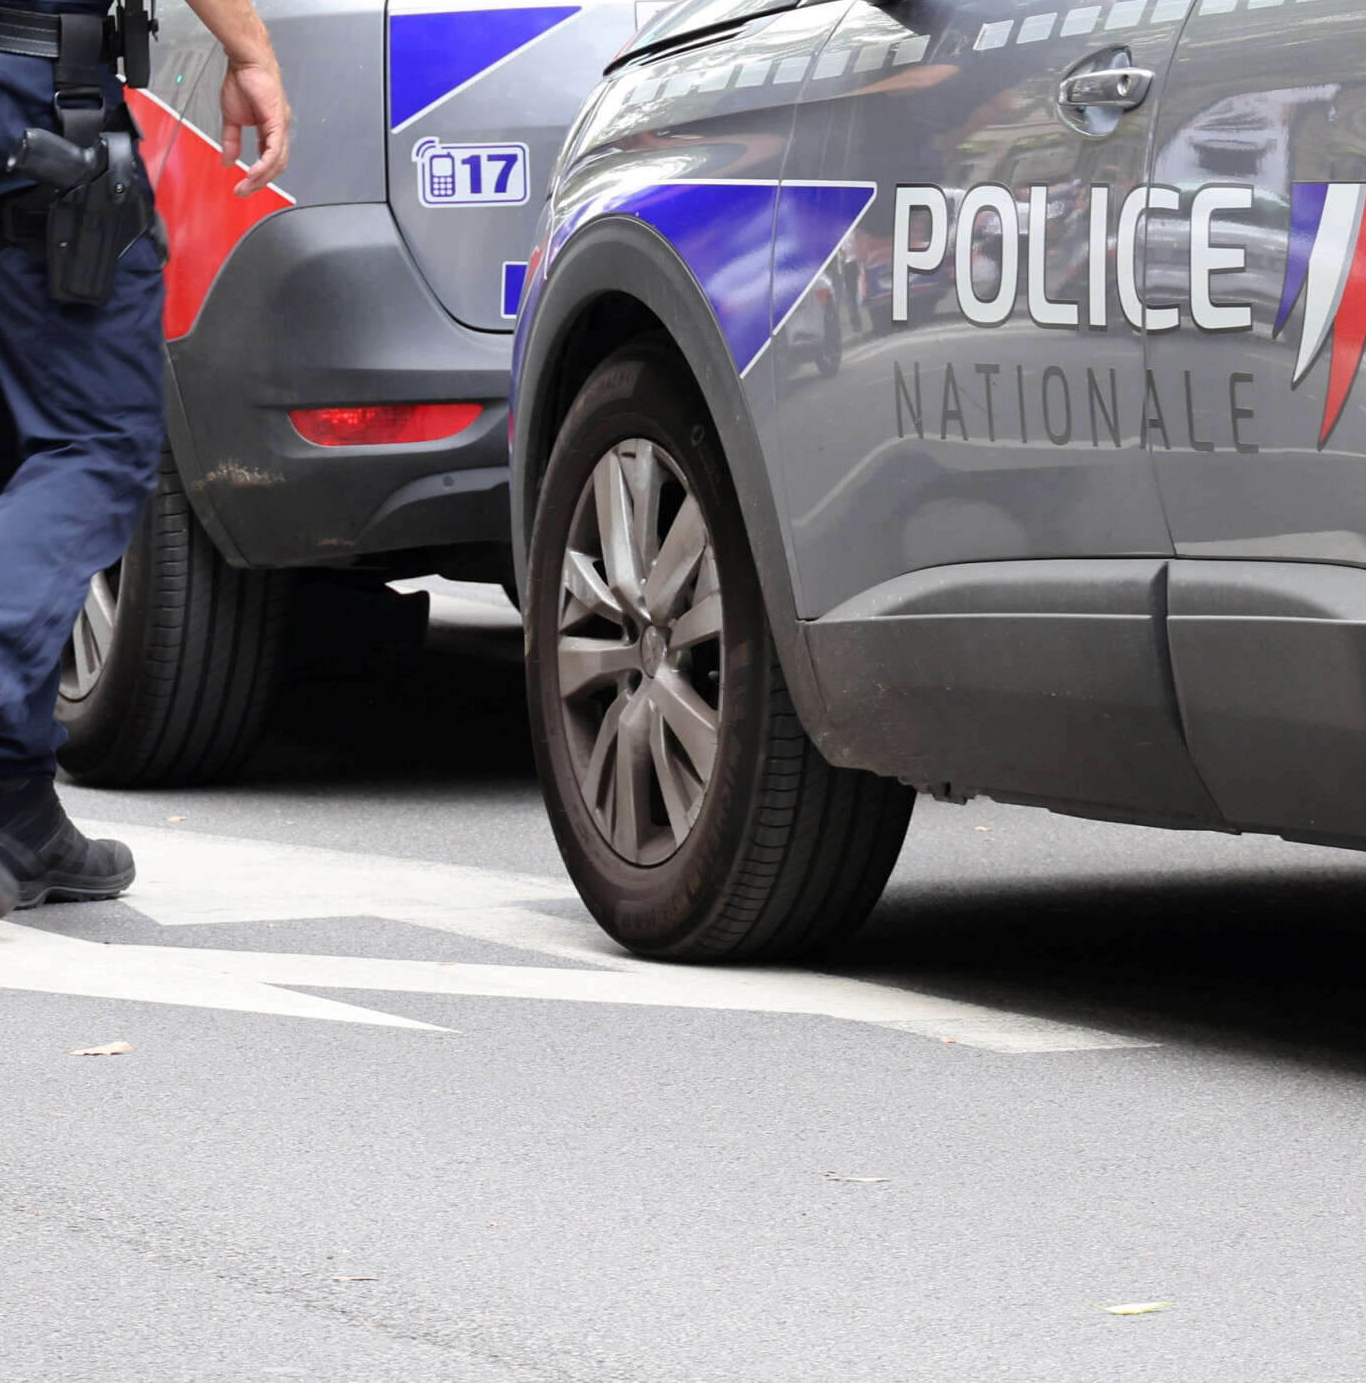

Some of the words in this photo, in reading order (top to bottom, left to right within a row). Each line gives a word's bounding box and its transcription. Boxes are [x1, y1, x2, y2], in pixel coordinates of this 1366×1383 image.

[461, 154, 519, 194] 17
[891, 181, 1254, 334] POLICE
[893, 360, 1260, 454] NATIONALE
